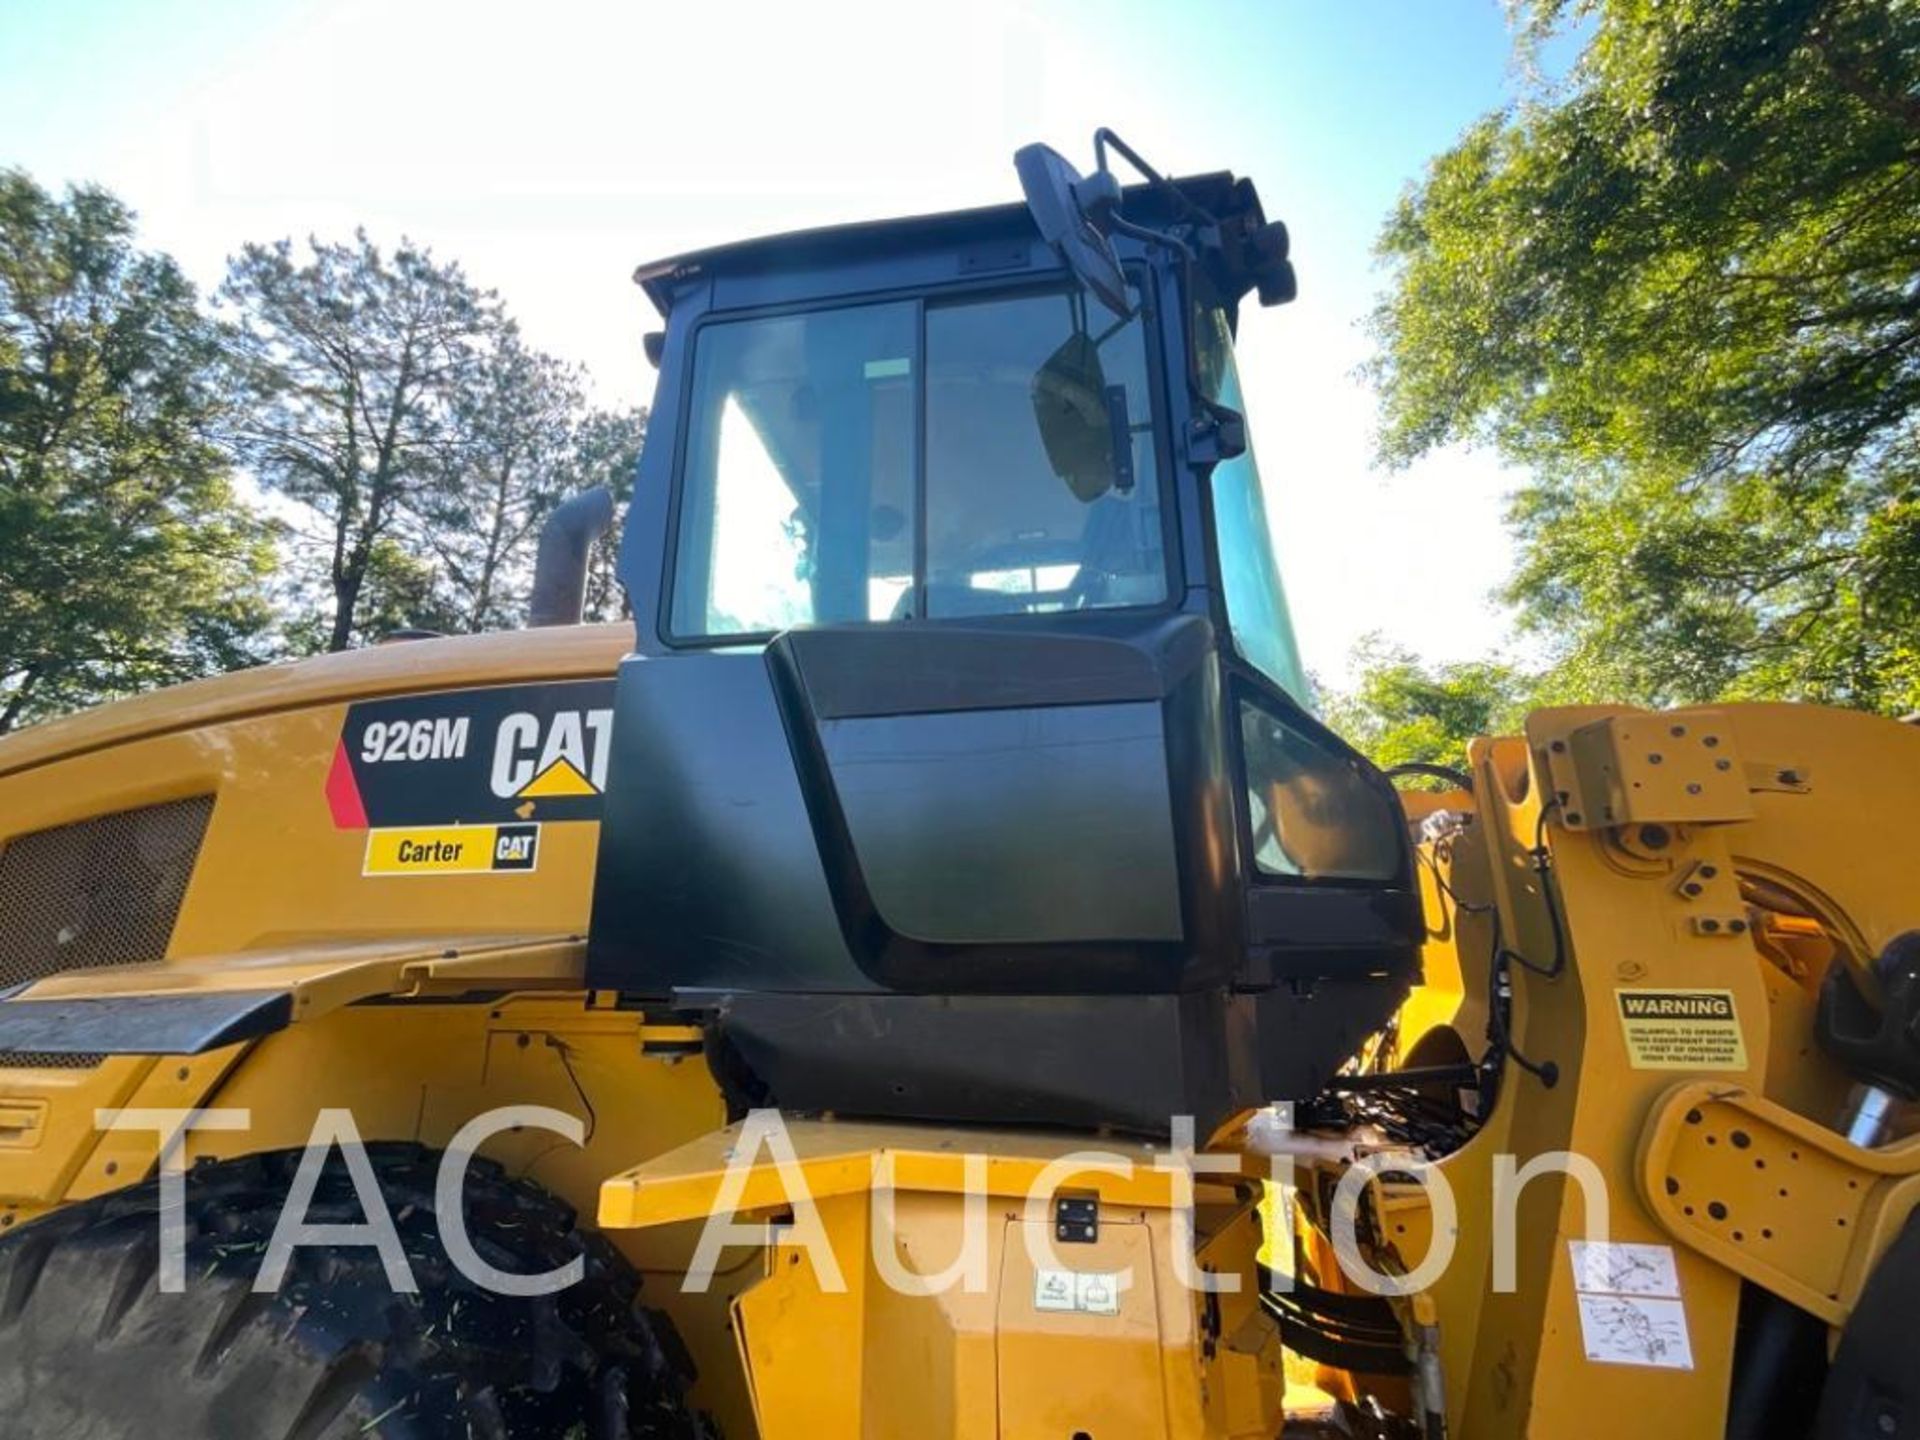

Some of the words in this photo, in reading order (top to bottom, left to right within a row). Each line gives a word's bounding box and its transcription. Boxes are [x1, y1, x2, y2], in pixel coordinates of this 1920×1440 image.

[361, 717, 470, 763] 926M
[490, 709, 614, 798] CAT
[398, 839, 463, 863] Carter
[496, 835, 534, 860] CAT
[1625, 999, 1729, 1015] WARNING
